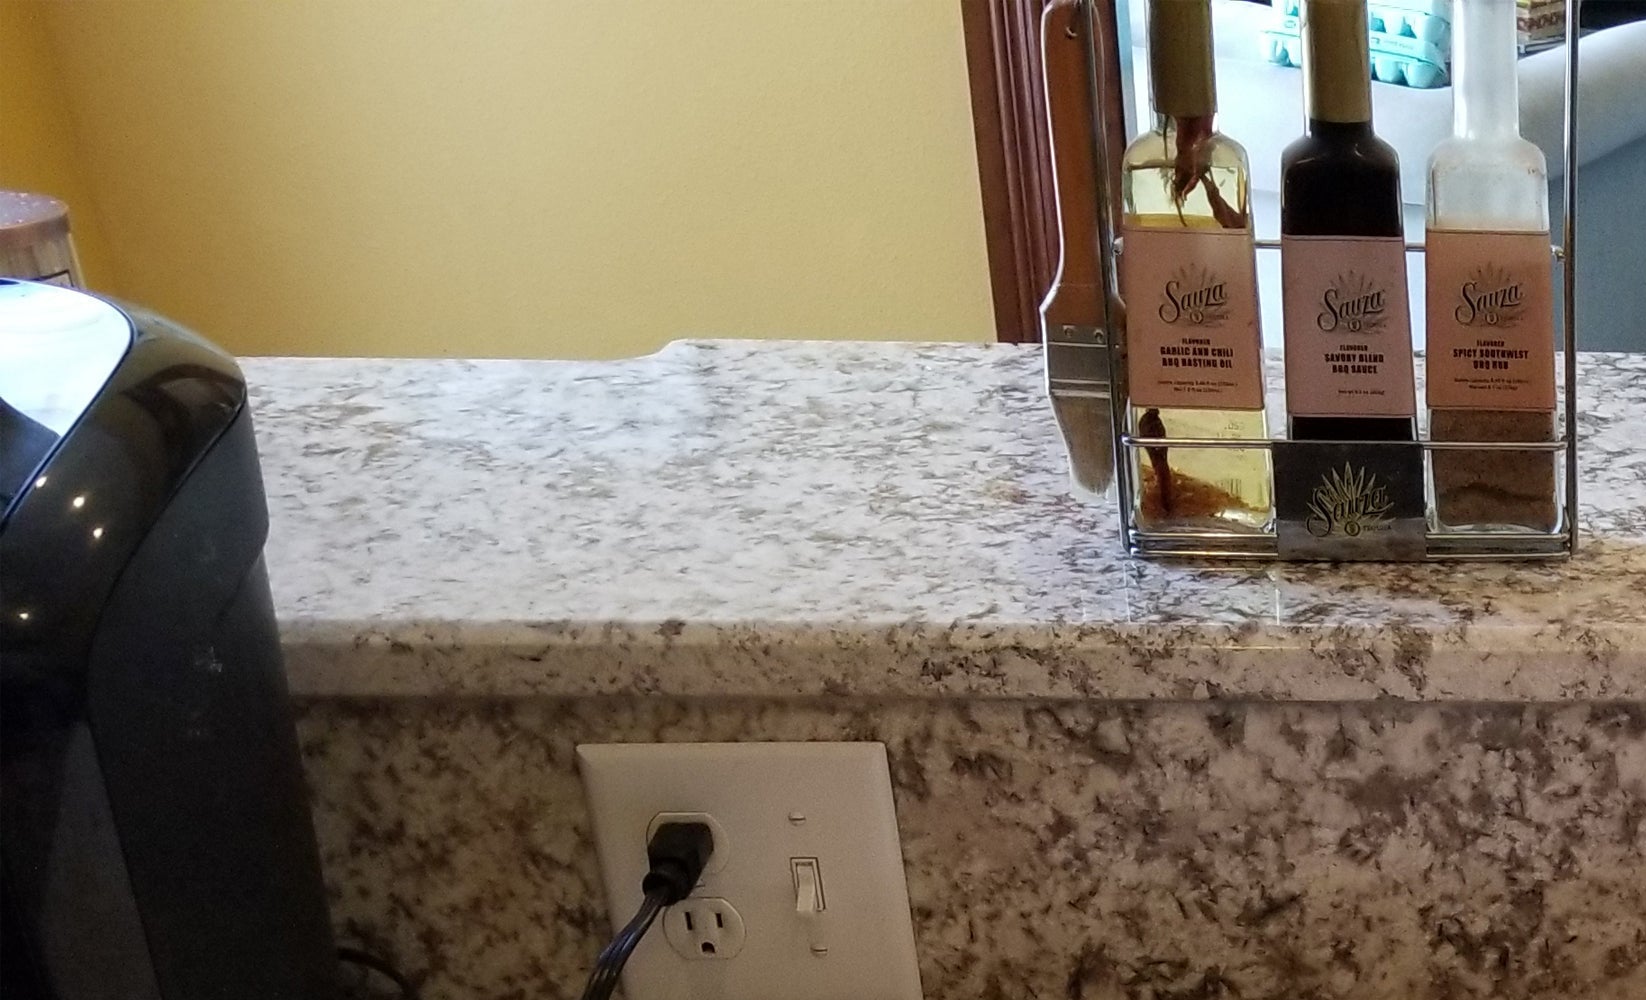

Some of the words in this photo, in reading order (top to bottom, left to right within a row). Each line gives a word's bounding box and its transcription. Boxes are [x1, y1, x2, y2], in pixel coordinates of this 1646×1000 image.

[1158, 280, 1228, 324] Sauza
[1454, 281, 1524, 326] Sauza
[1316, 288, 1386, 332] Sauza
[1160, 346, 1190, 356] GARLIC
[1192, 347, 1209, 357] AND
[1211, 348, 1234, 357] CHILI
[1453, 349, 1477, 358] SPICY
[1480, 349, 1529, 359] SOUTHWEST
[1162, 358, 1179, 367] BBQ
[1181, 358, 1218, 368] BASTING
[1220, 359, 1233, 369] OIL
[1324, 353, 1356, 362] SAVORY
[1358, 353, 1384, 363] BLEND
[1332, 364, 1349, 374] BBQ
[1351, 365, 1378, 374] SAUCE
[1306, 485, 1395, 538] Sauza
